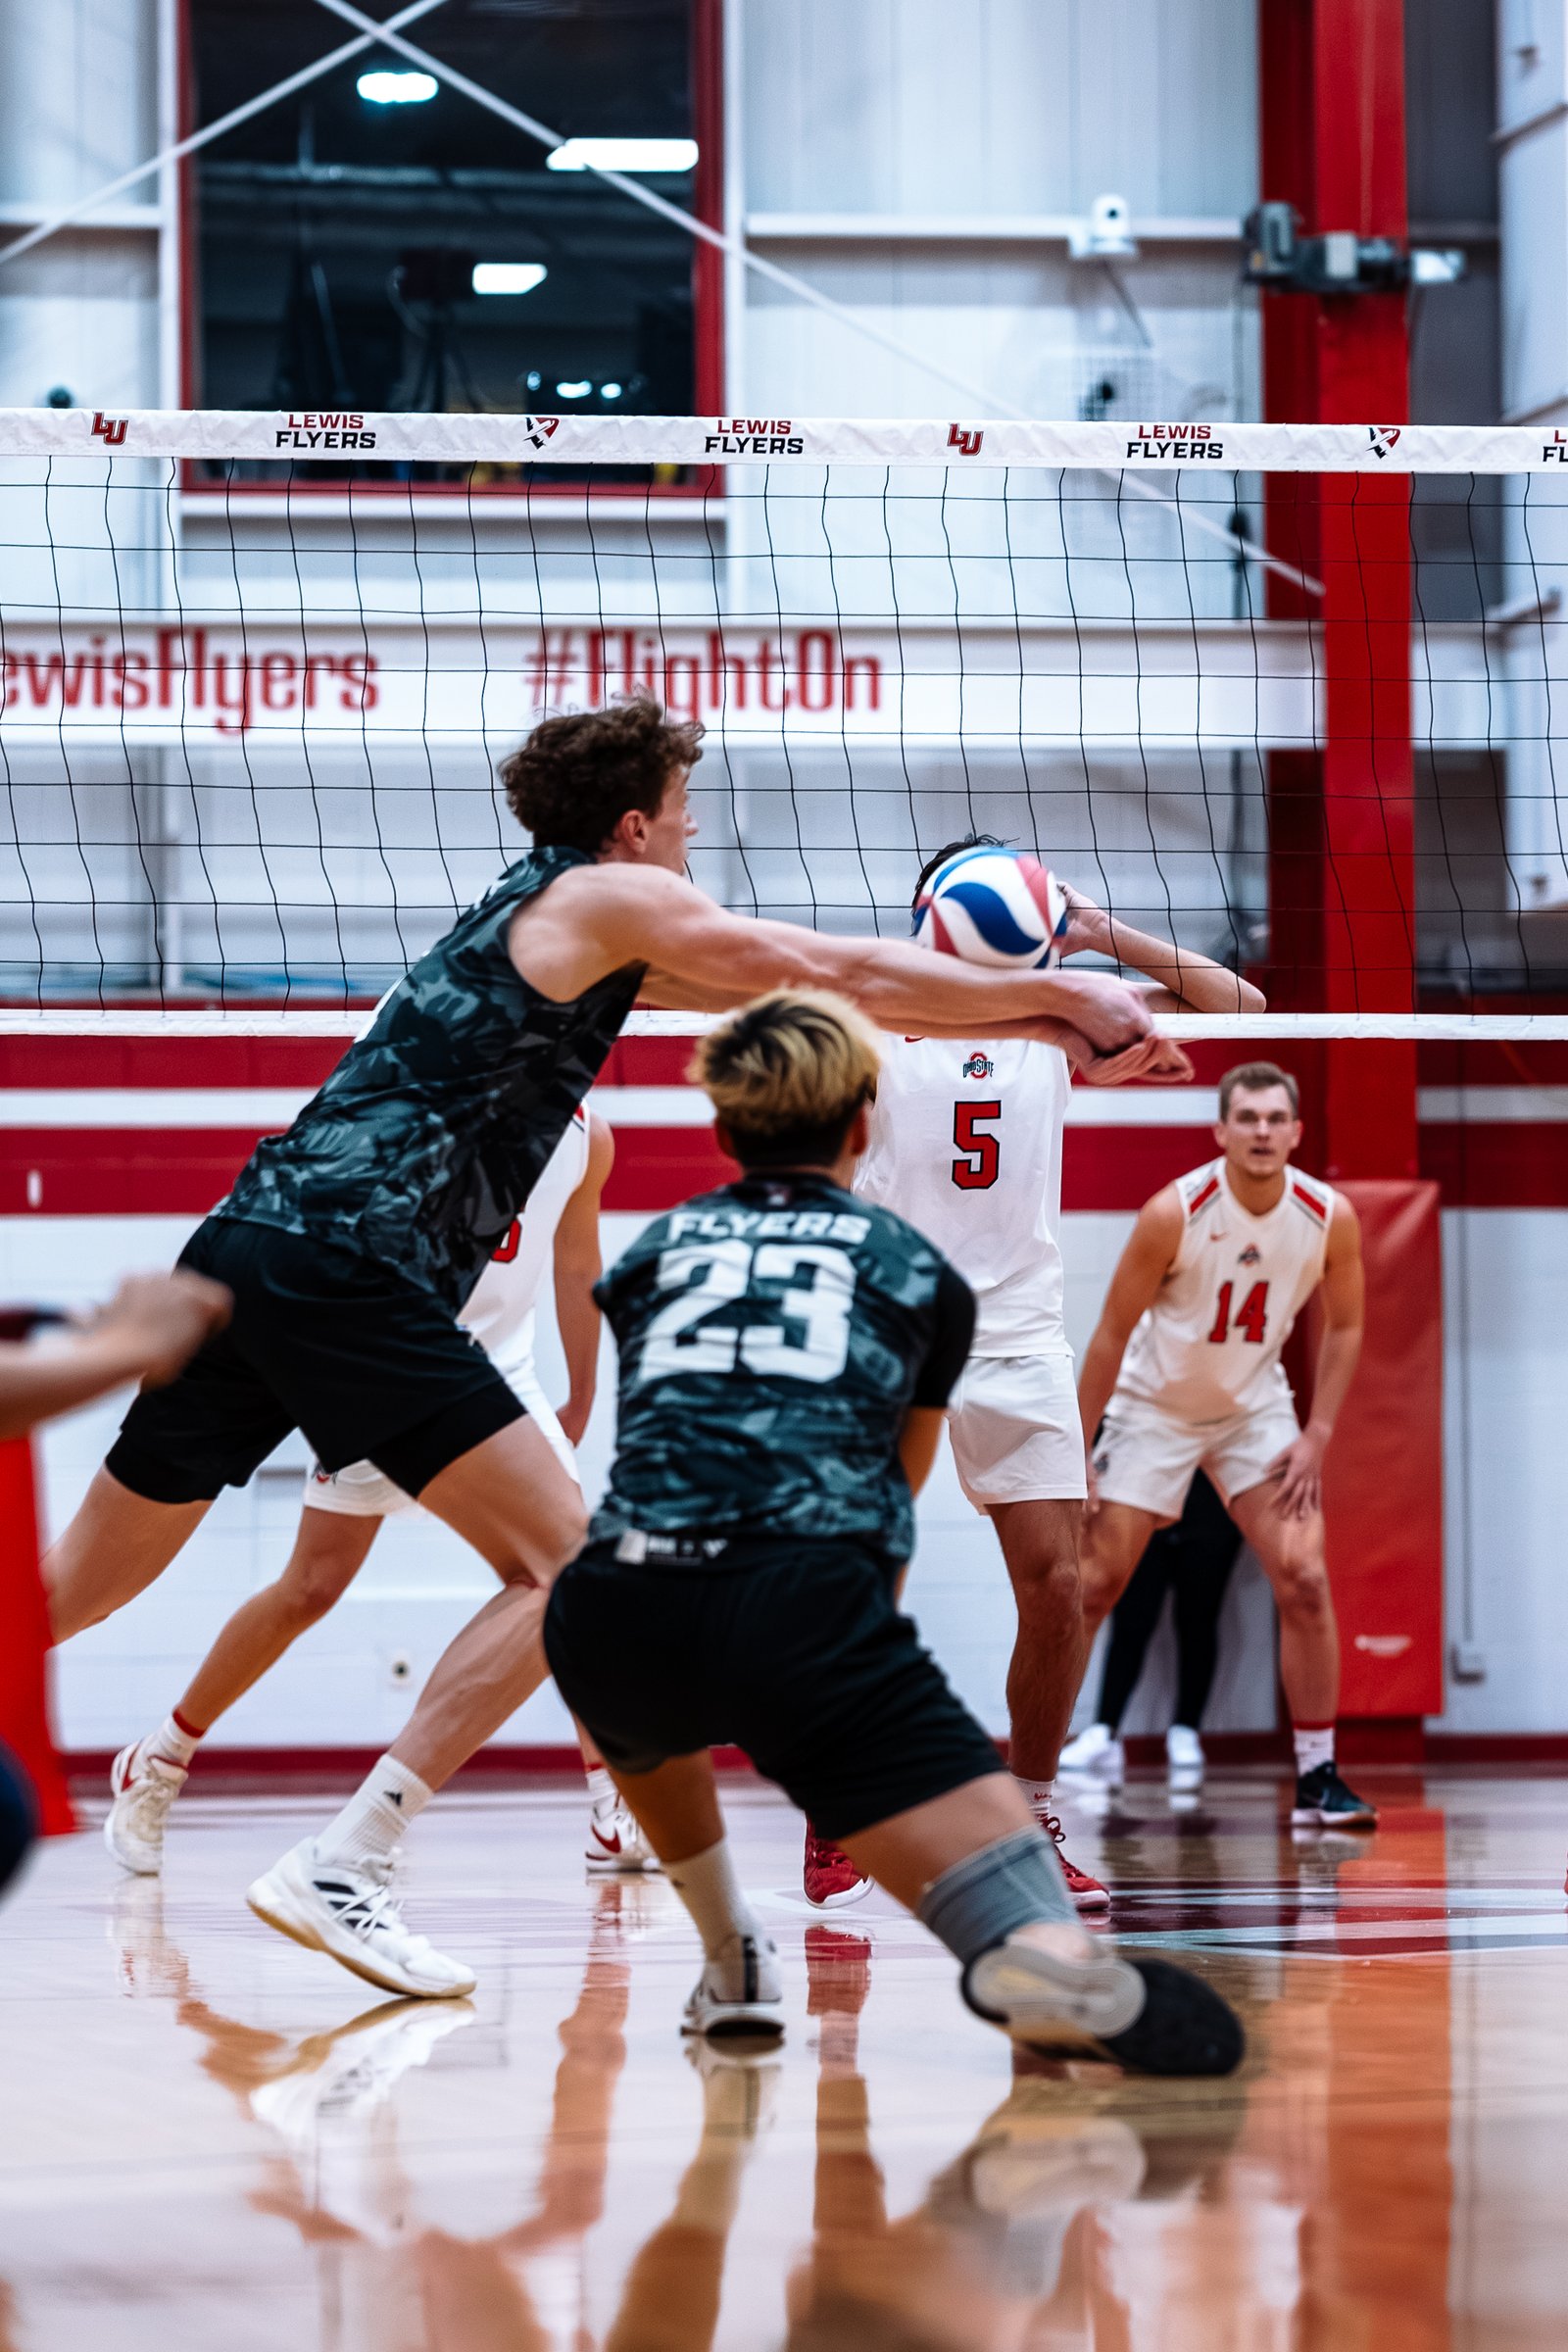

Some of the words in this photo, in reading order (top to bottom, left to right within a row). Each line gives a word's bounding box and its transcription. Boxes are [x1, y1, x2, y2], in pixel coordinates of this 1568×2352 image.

[288, 414, 364, 429] LEWIS
[717, 419, 791, 434] LEWIS
[275, 431, 376, 449] FLYERS
[1138, 424, 1211, 439] LEWIS
[705, 436, 804, 454] FLYERS
[1127, 442, 1223, 459] FLYERS
[523, 628, 882, 723] #FlightOn
[952, 1100, 1002, 1190] 5
[666, 1211, 871, 1245] FLYERS
[639, 1238, 858, 1384] 23
[1207, 1280, 1269, 1344] 14
